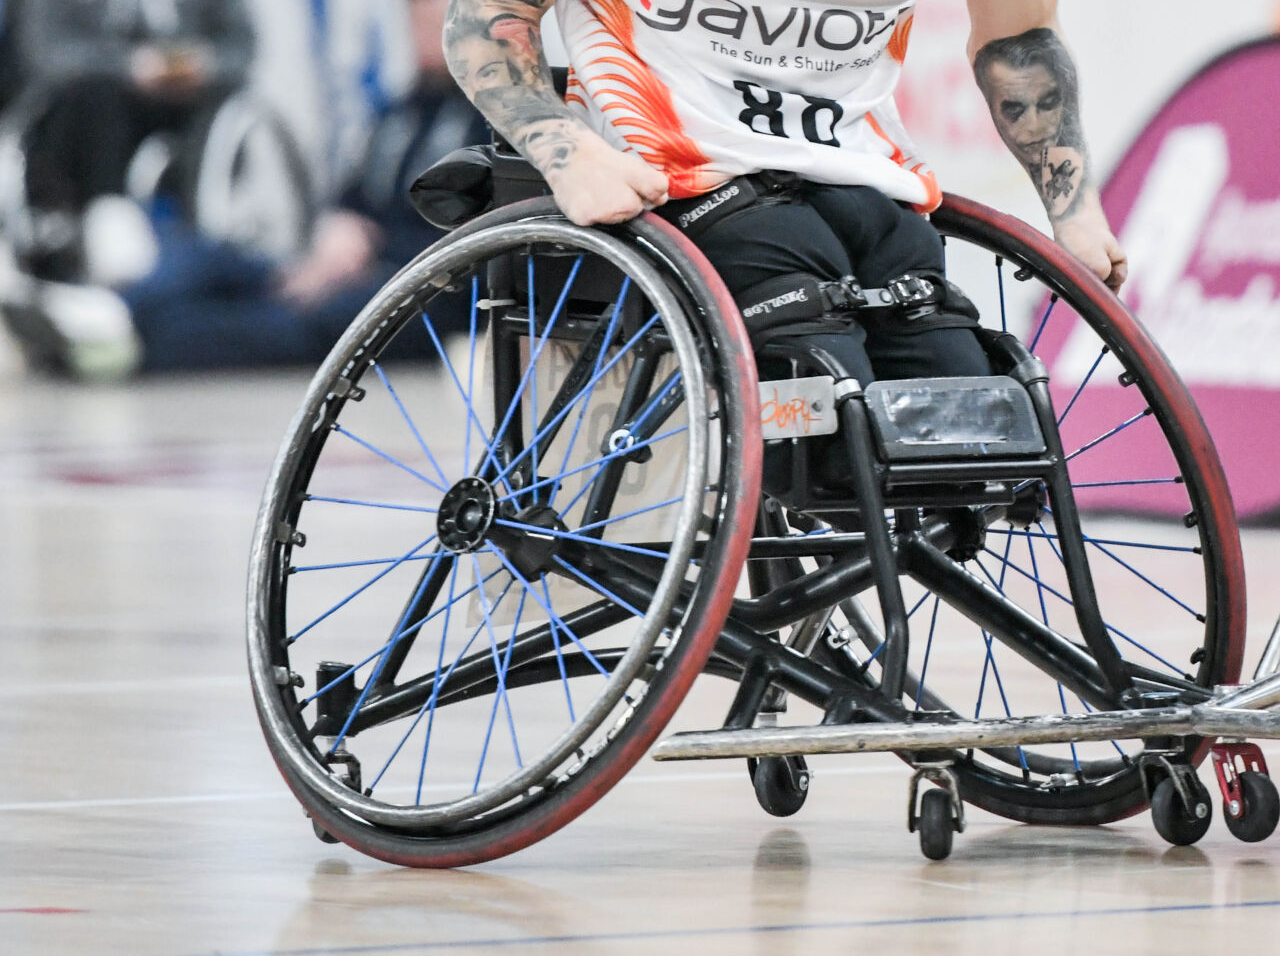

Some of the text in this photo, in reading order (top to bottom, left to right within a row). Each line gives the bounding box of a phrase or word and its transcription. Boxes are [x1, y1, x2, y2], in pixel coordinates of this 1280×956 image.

[711, 40, 738, 58] The
[743, 50, 772, 66] Sun
[778, 55, 788, 68] &
[733, 80, 844, 148] 80
